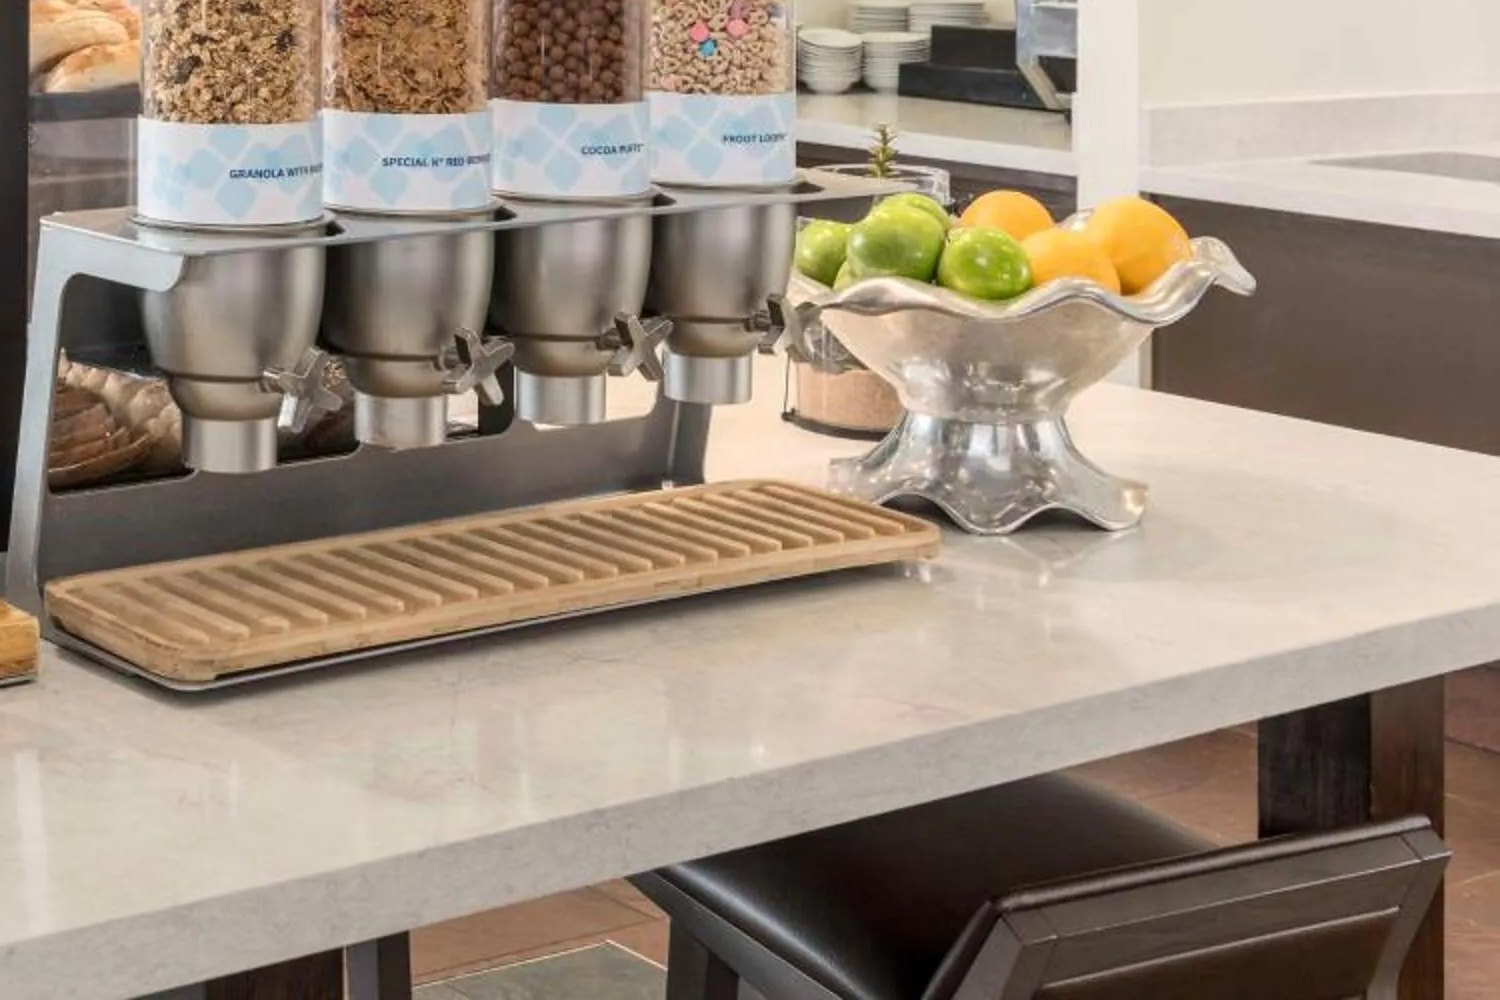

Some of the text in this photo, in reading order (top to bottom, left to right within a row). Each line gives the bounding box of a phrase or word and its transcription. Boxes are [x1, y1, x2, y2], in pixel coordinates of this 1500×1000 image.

[580, 145, 617, 155] COCOA
[382, 157, 428, 167] SPECIAL
[229, 168, 285, 179] GRANOLA
